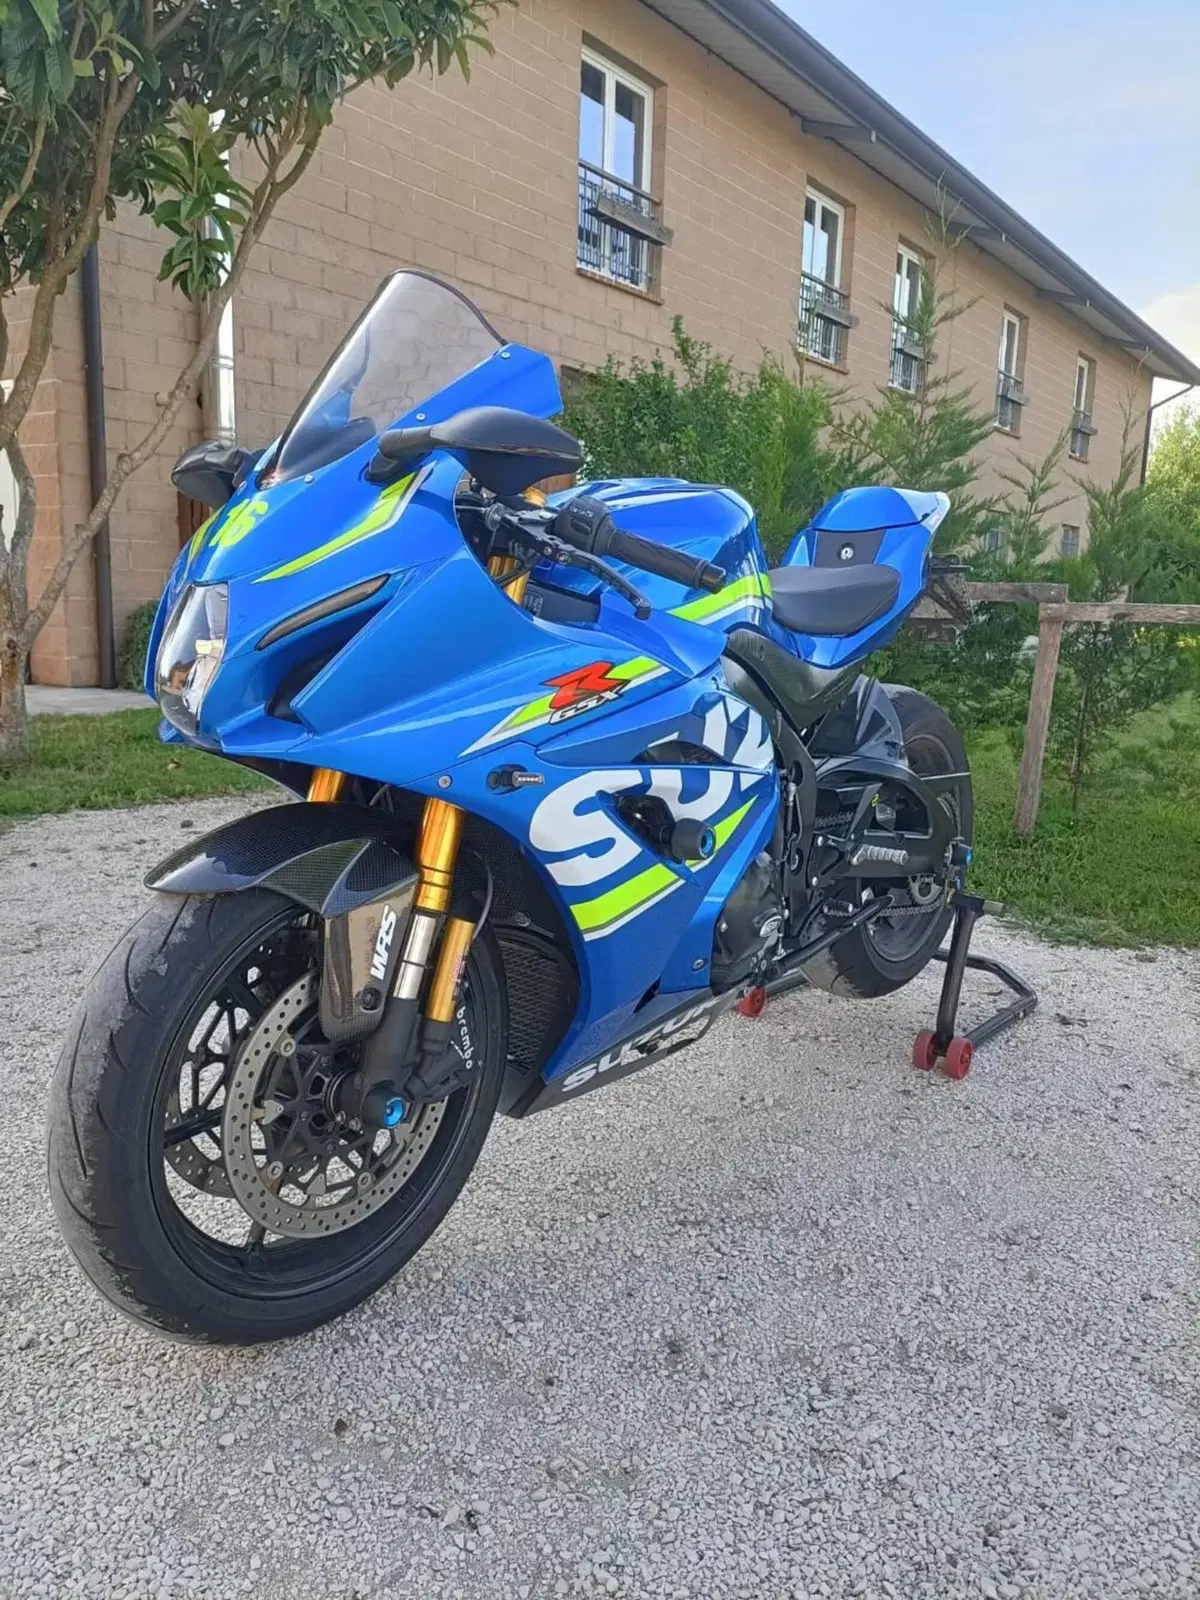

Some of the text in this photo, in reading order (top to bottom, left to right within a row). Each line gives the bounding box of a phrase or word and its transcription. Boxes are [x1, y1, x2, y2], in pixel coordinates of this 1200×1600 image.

[549, 681, 627, 725] GSX
[370, 904, 397, 980] WRS
[456, 1006, 475, 1069] brembo
